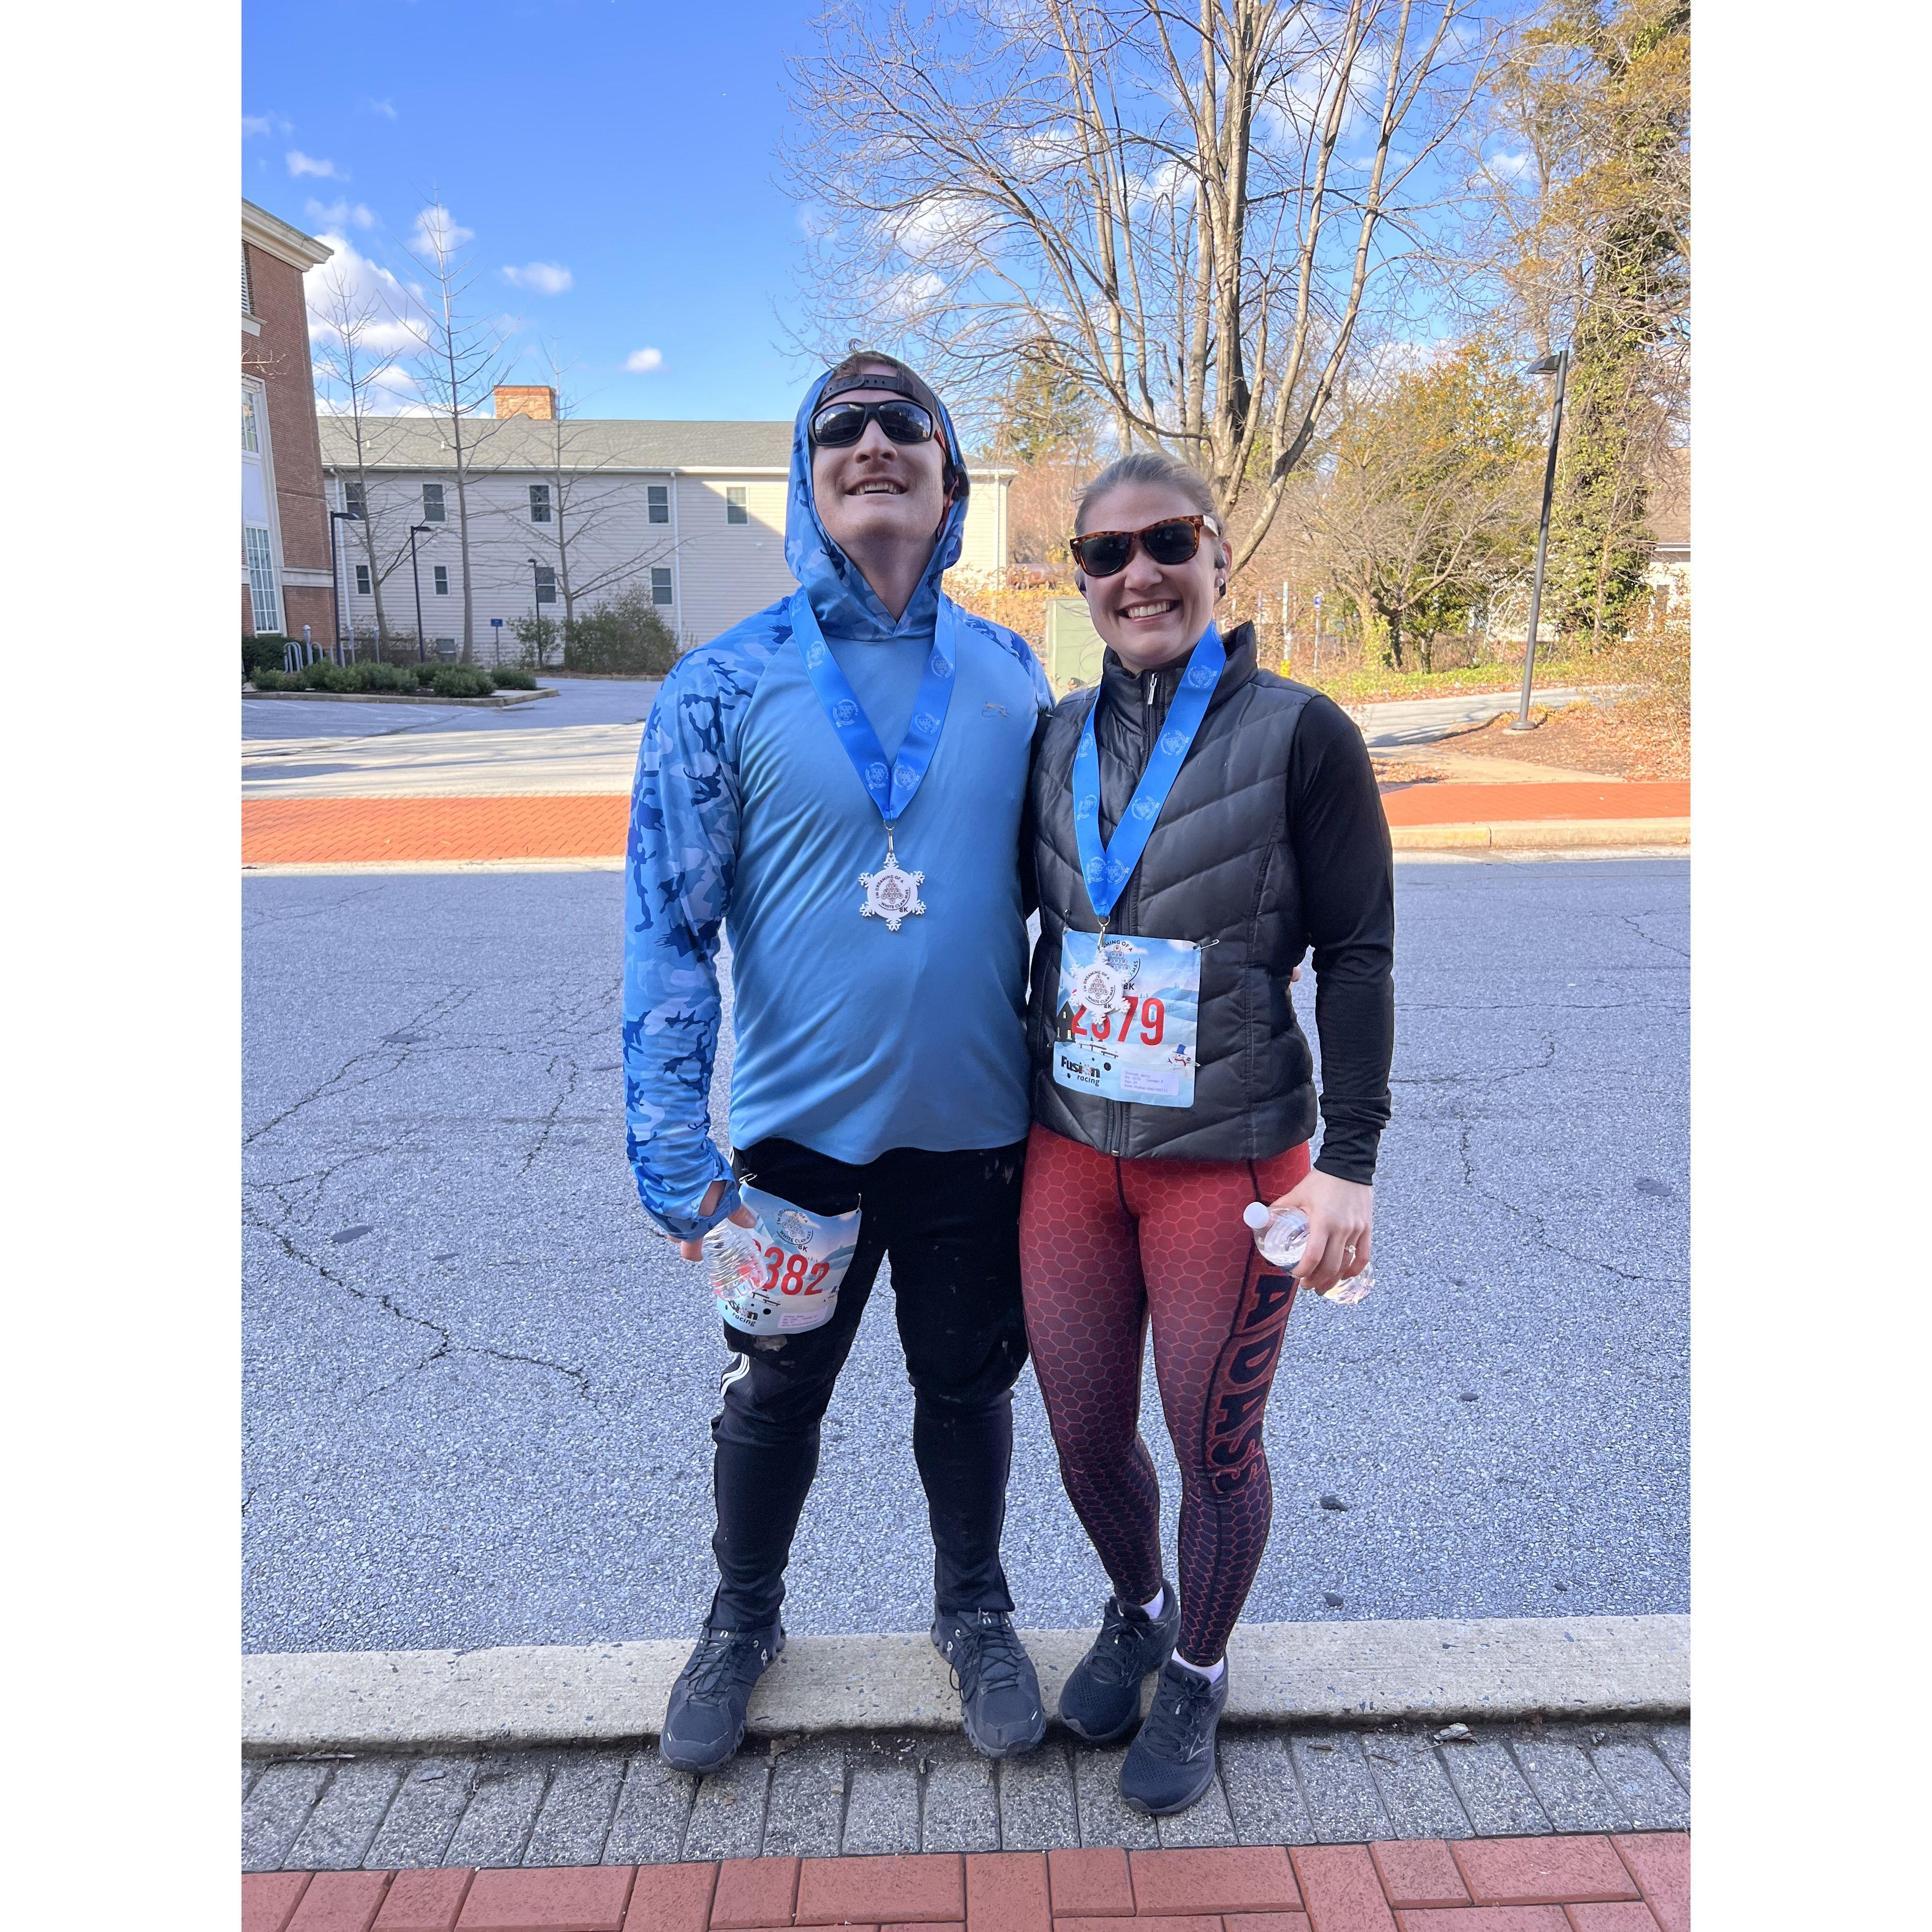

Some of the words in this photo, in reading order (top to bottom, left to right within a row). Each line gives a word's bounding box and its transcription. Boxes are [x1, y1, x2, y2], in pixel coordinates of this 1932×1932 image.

[1123, 982, 1135, 990] 8K
[1077, 1074, 1100, 1087] racing
[780, 1230, 794, 1242] WHITE
[798, 1244, 808, 1253] 8K
[752, 1239, 830, 1296] 382
[732, 1312, 756, 1327] racing
